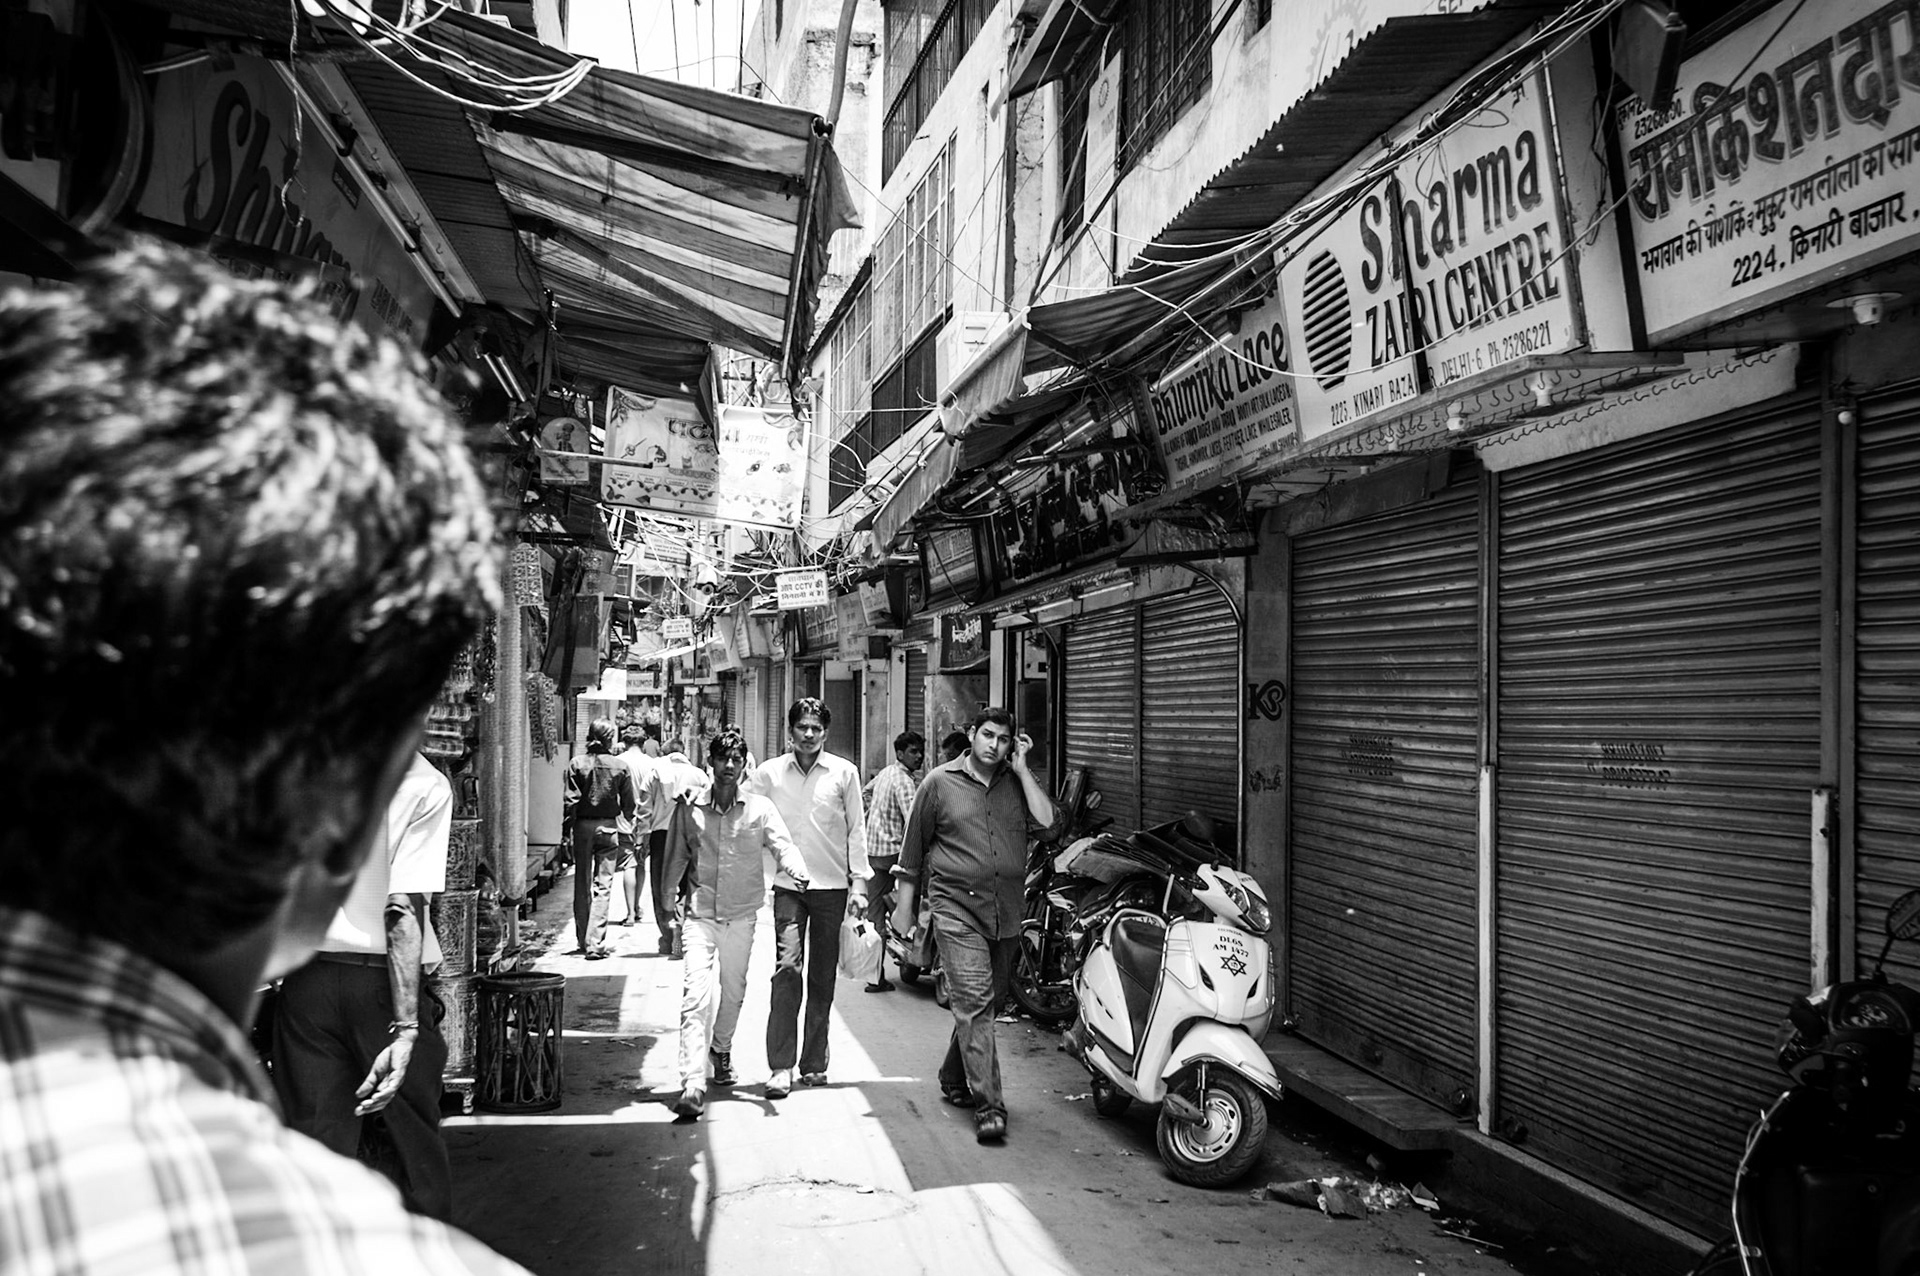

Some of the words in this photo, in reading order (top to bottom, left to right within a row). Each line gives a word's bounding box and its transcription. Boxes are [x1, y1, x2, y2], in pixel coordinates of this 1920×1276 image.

[1359, 130, 1542, 294] Sharma
[1641, 234, 1684, 274] भगवान
[1685, 219, 1702, 257] की
[1754, 187, 1788, 237] मुकुट
[1863, 142, 1887, 181] का
[1790, 207, 1845, 265] किनारी
[1445, 222, 1561, 333] CENTRE
[1151, 354, 1234, 436] Bhumika
[1230, 322, 1289, 393] Lace
[1353, 384, 1384, 417] KINARI
[795, 582, 812, 591] CCTV
